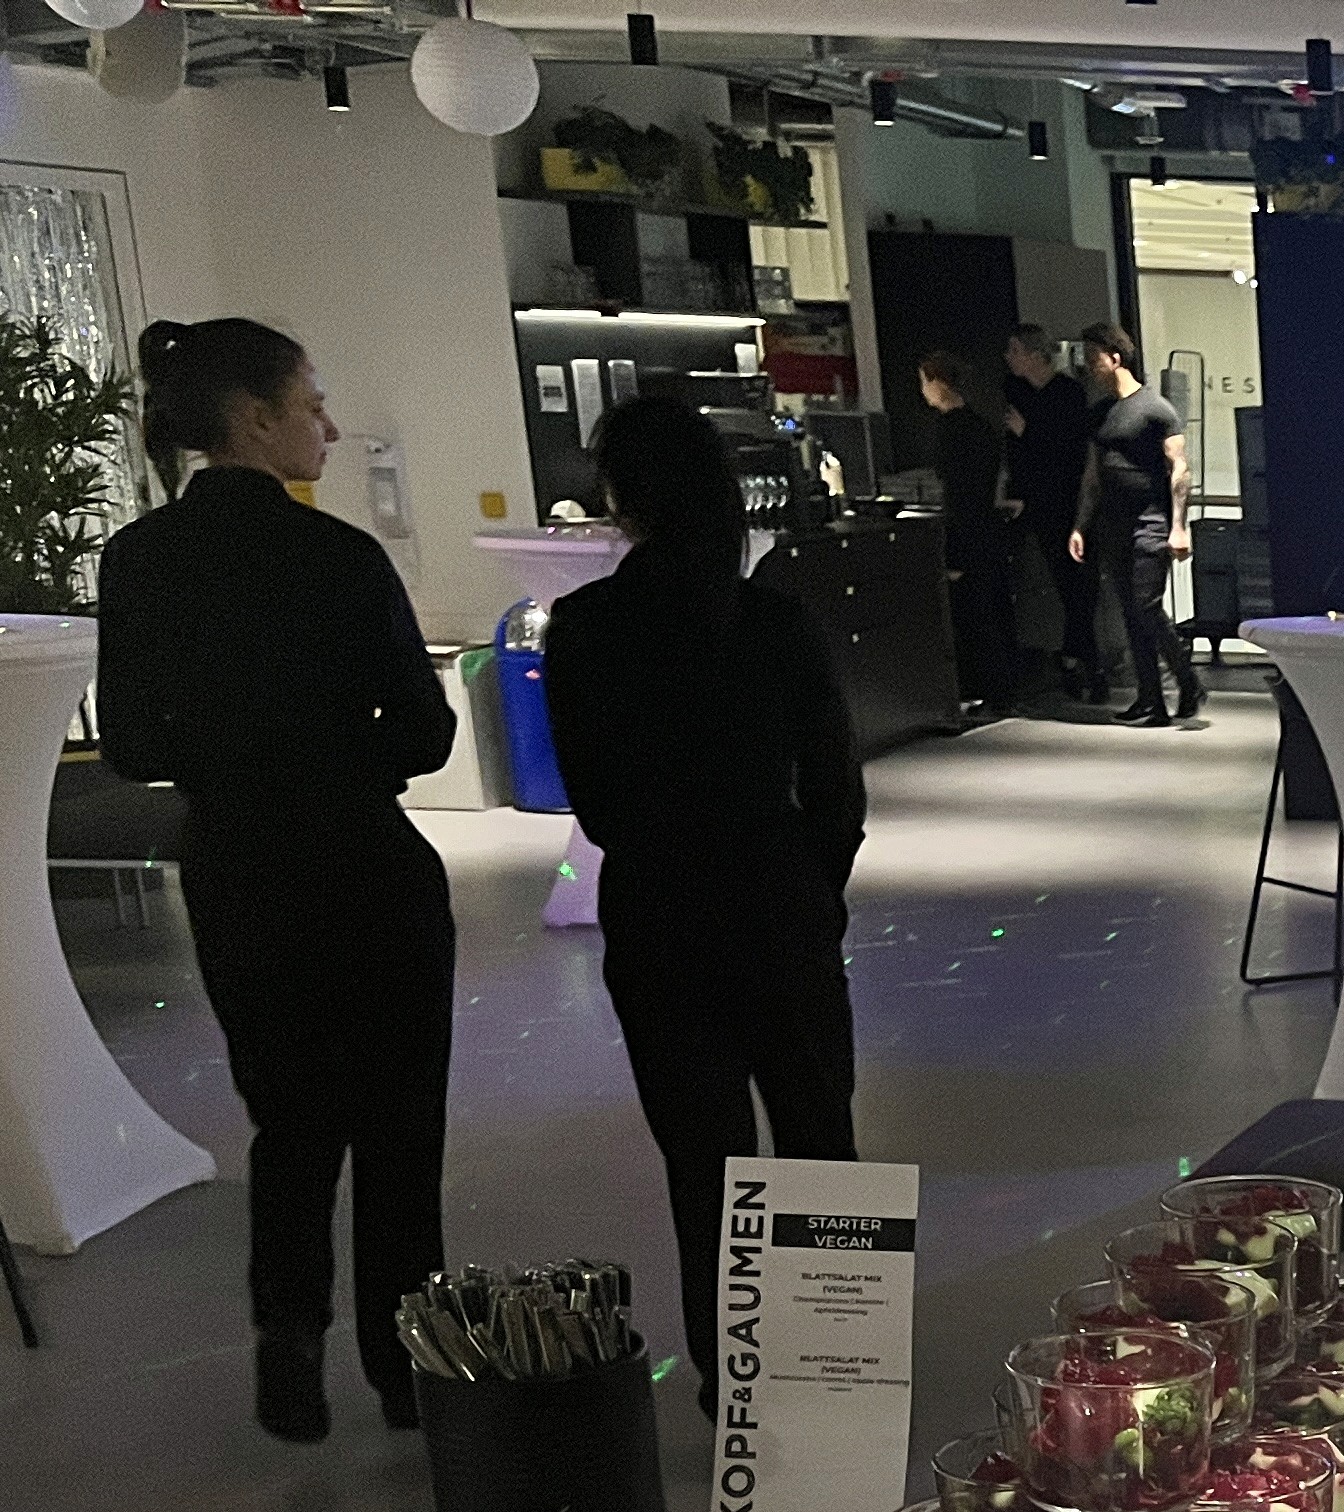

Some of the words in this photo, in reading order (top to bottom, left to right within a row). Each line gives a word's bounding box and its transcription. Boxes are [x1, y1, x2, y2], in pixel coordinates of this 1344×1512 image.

[808, 1217, 882, 1231] STARTER
[815, 1234, 873, 1249] VEGAN
[823, 1285, 863, 1295] (VEGAN)
